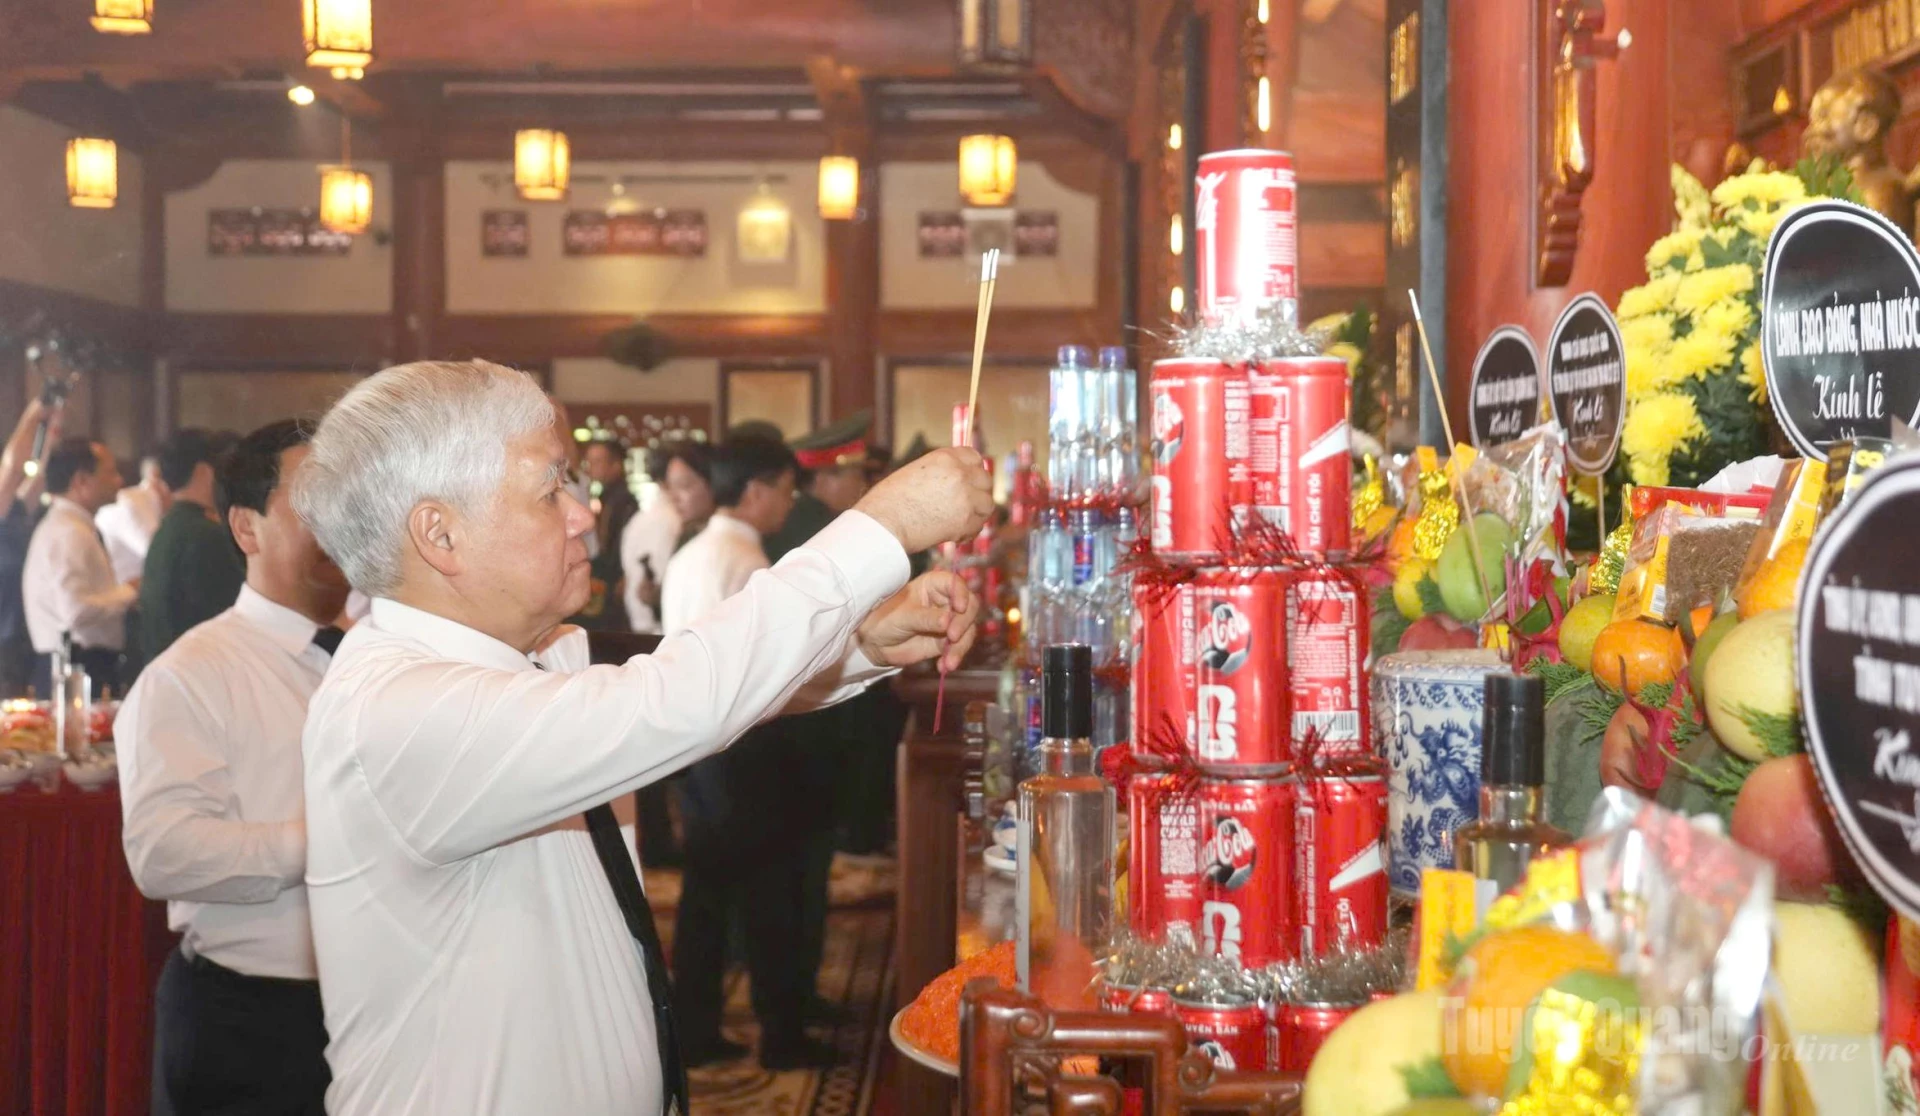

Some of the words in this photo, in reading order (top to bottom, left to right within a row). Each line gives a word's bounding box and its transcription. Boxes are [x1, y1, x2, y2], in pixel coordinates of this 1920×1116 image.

[1860, 290, 1885, 352] NHÀ
[1812, 374, 1862, 420] Kính
[1866, 371, 1885, 419] lễ
